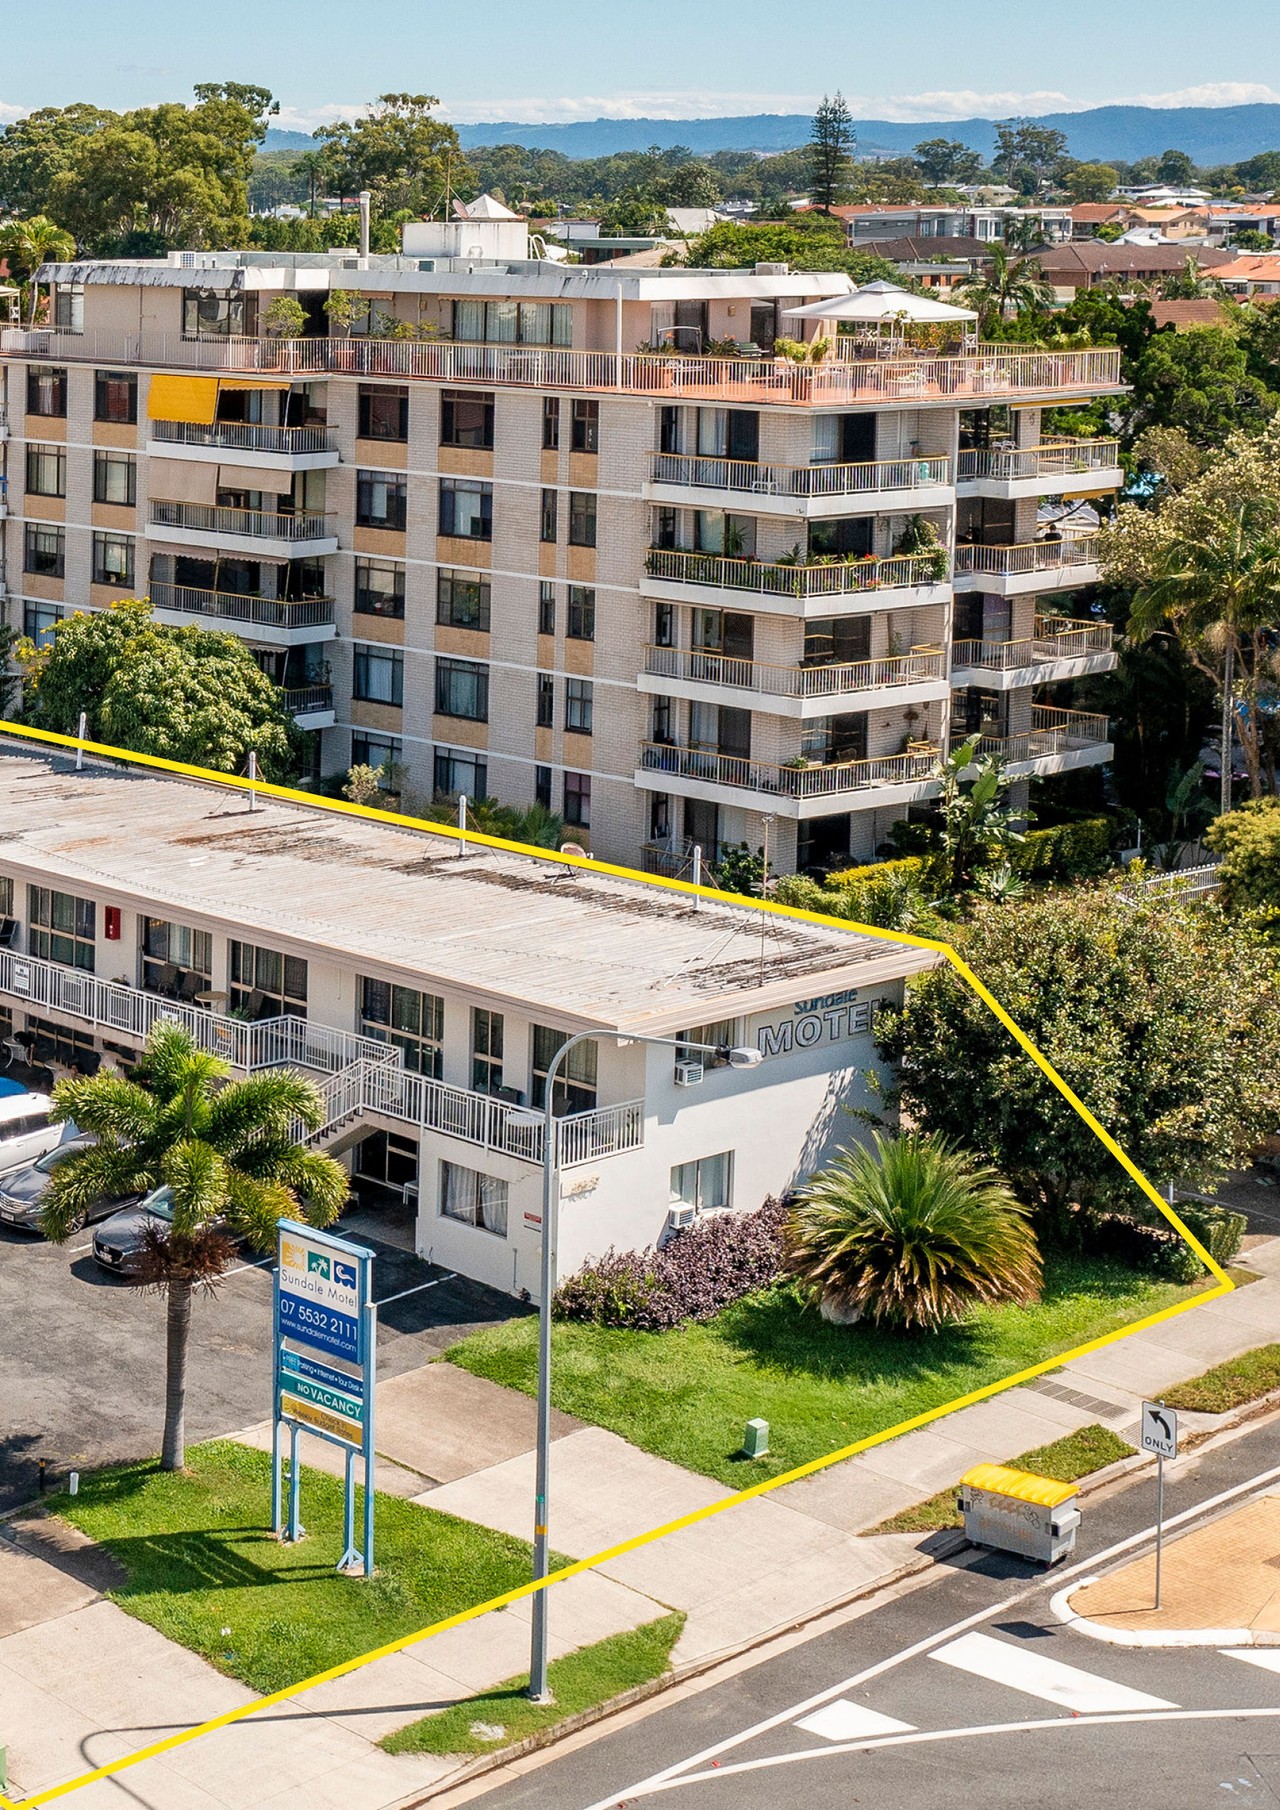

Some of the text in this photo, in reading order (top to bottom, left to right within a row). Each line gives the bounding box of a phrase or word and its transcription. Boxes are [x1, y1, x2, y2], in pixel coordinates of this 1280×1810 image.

[281, 1269, 357, 1308] Sundale Motel
[280, 1299, 357, 1341] 07 5532 2111
[280, 1318, 357, 1352] www.sundalemotel.com
[296, 1382, 361, 1417] NO VACANCY
[1144, 1436, 1174, 1453] ONLY
